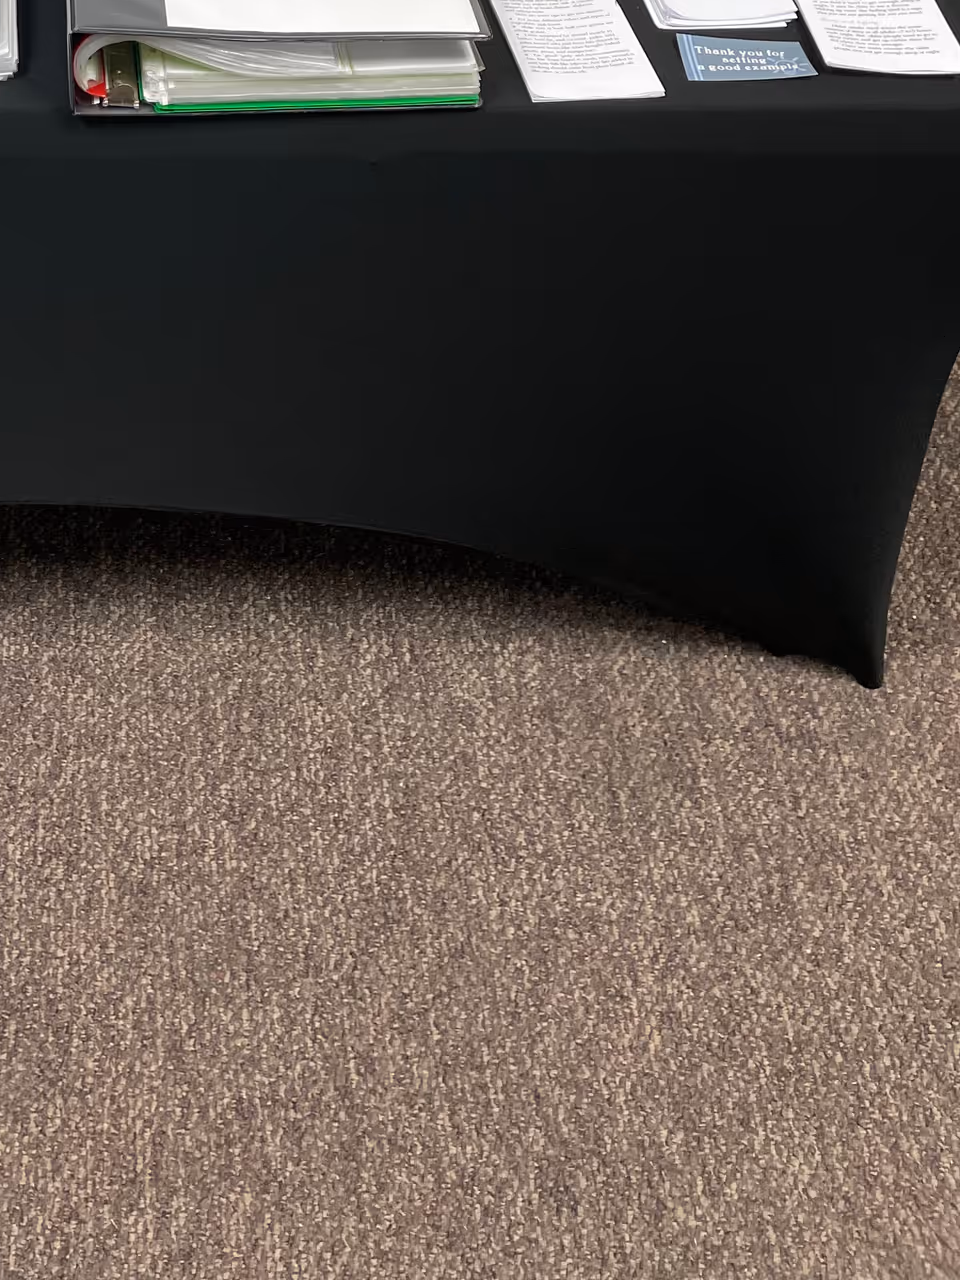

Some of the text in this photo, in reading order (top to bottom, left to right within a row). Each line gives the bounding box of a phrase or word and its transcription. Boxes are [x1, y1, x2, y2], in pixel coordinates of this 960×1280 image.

[694, 45, 784, 58] Thank you for
[745, 63, 799, 71] example
